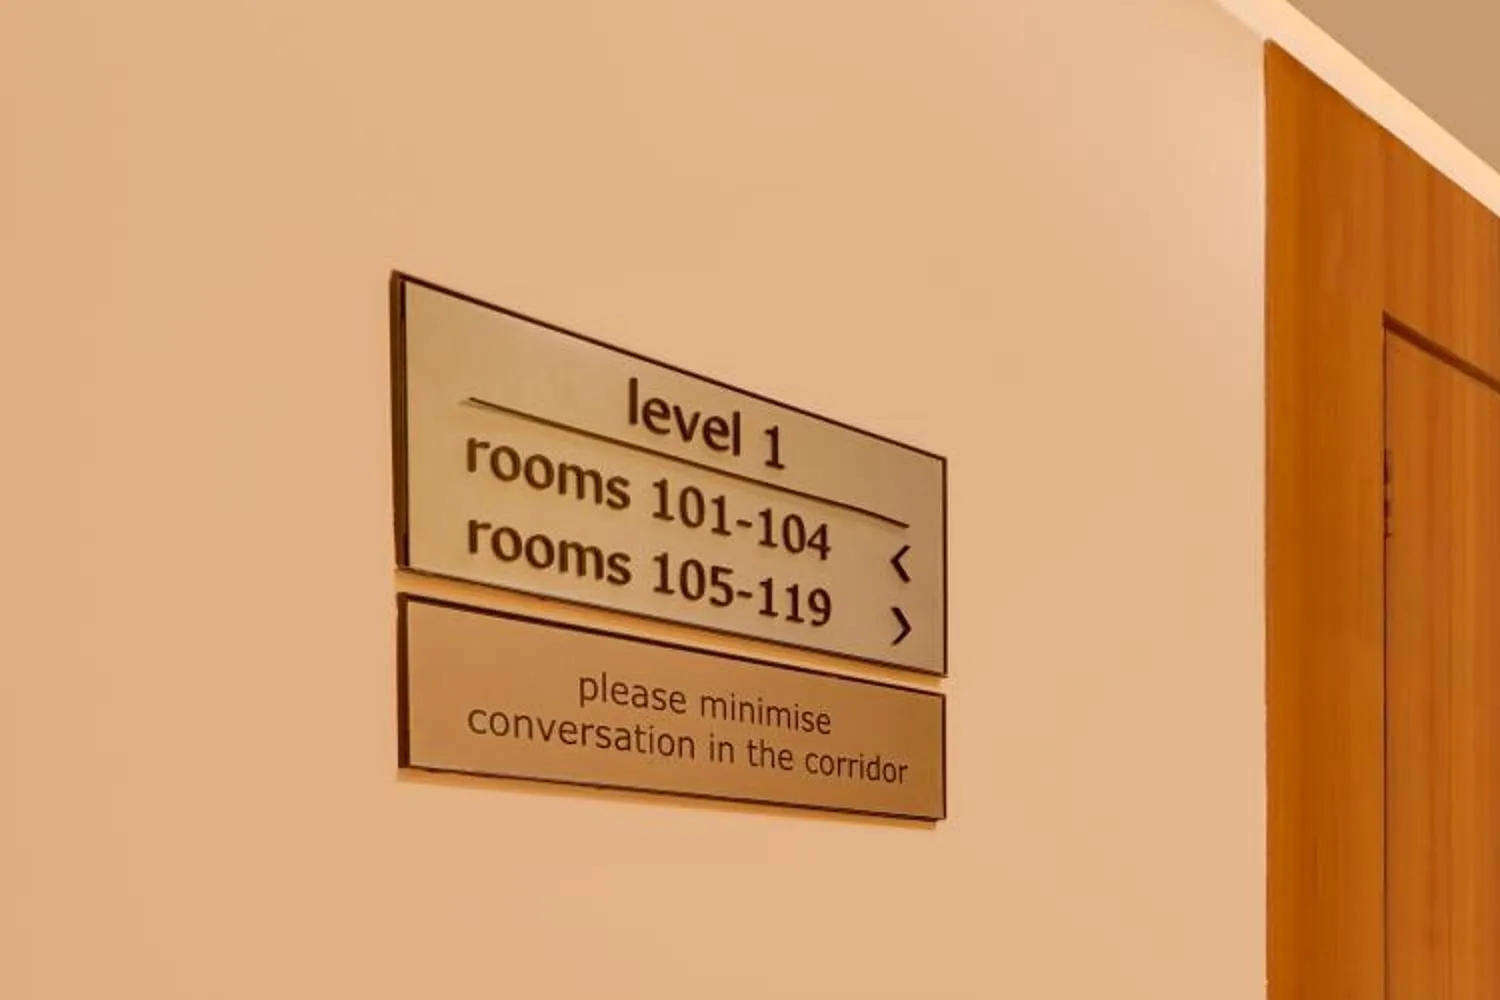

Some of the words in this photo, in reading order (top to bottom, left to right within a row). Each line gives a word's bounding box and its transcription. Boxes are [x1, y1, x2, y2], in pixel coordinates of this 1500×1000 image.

[628, 377, 742, 457] level
[764, 425, 786, 469] 1
[466, 435, 631, 511] rooms
[652, 478, 832, 561] 101-104
[467, 517, 632, 586] rooms
[653, 553, 832, 627] 105-119
[468, 707, 695, 760] conversation
[709, 733, 735, 763] in
[747, 737, 793, 770] the
[805, 752, 908, 784] corridor
[579, 672, 687, 714] please
[700, 692, 832, 735] minimise
